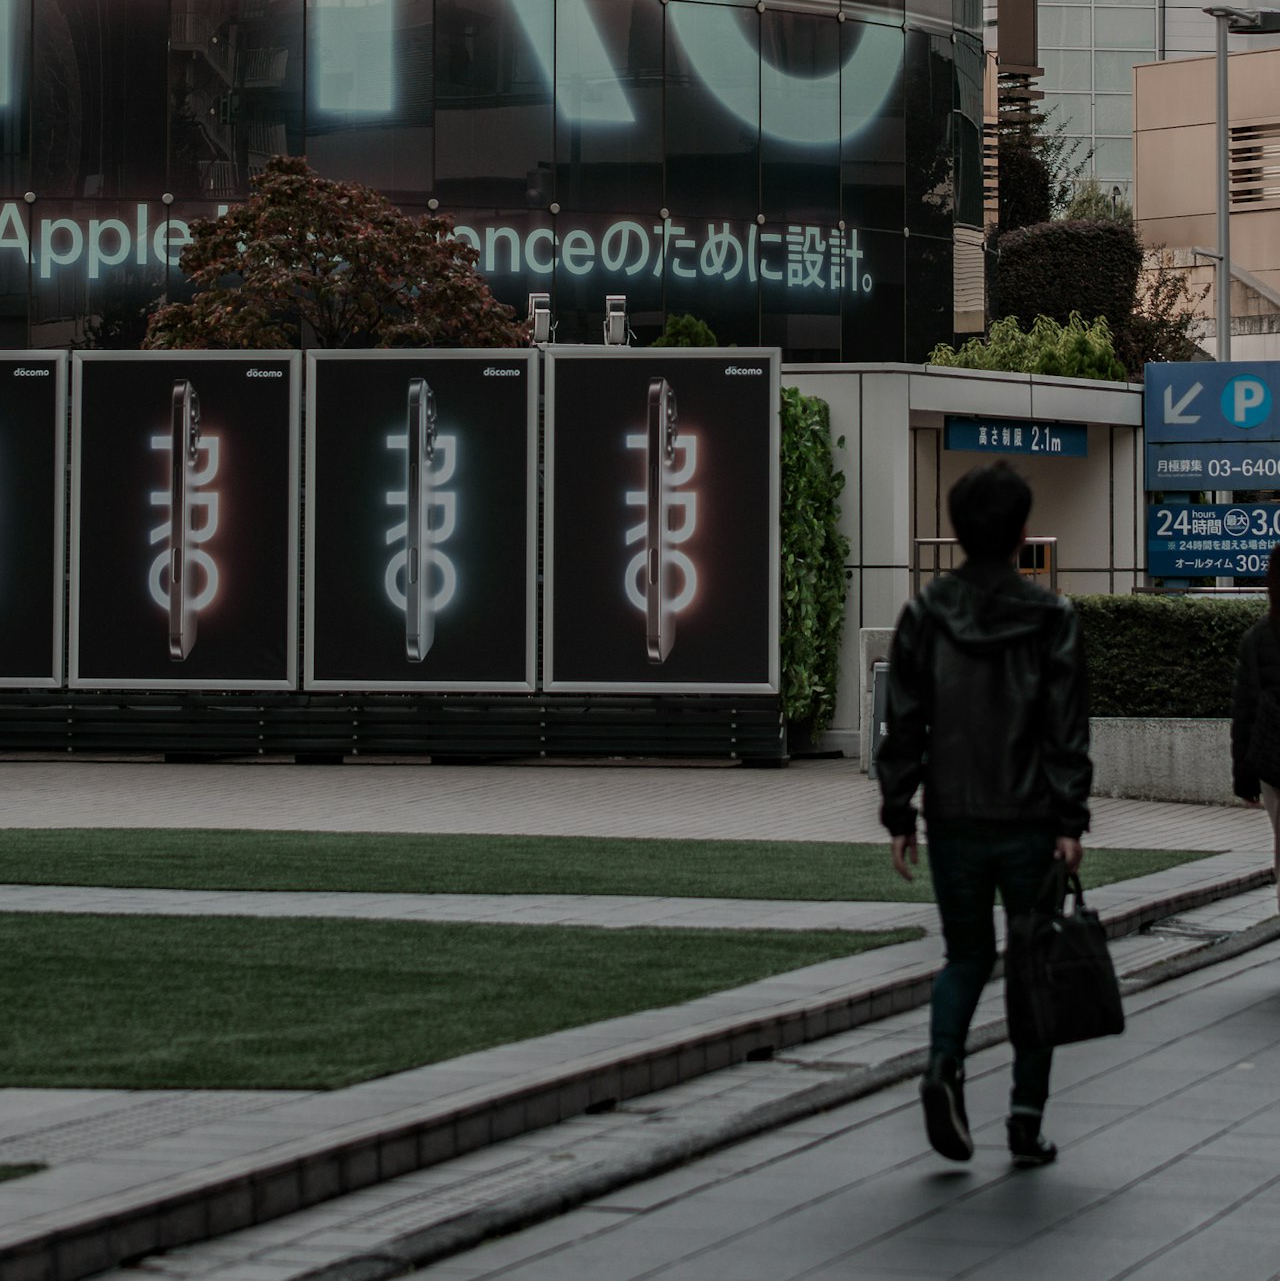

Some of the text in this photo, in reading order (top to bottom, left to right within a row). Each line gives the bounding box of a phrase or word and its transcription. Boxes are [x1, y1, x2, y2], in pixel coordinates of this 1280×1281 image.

[1233, 379, 1266, 423] P
[978, 425, 1062, 452] 高さ制限 2.1m
[1157, 459, 1203, 473] 月極募集
[147, 434, 221, 612] PRO
[384, 434, 458, 612] PRO
[624, 434, 698, 613] PRO
[1191, 509, 1217, 519] hours
[1175, 558, 1234, 570] オールタイム
